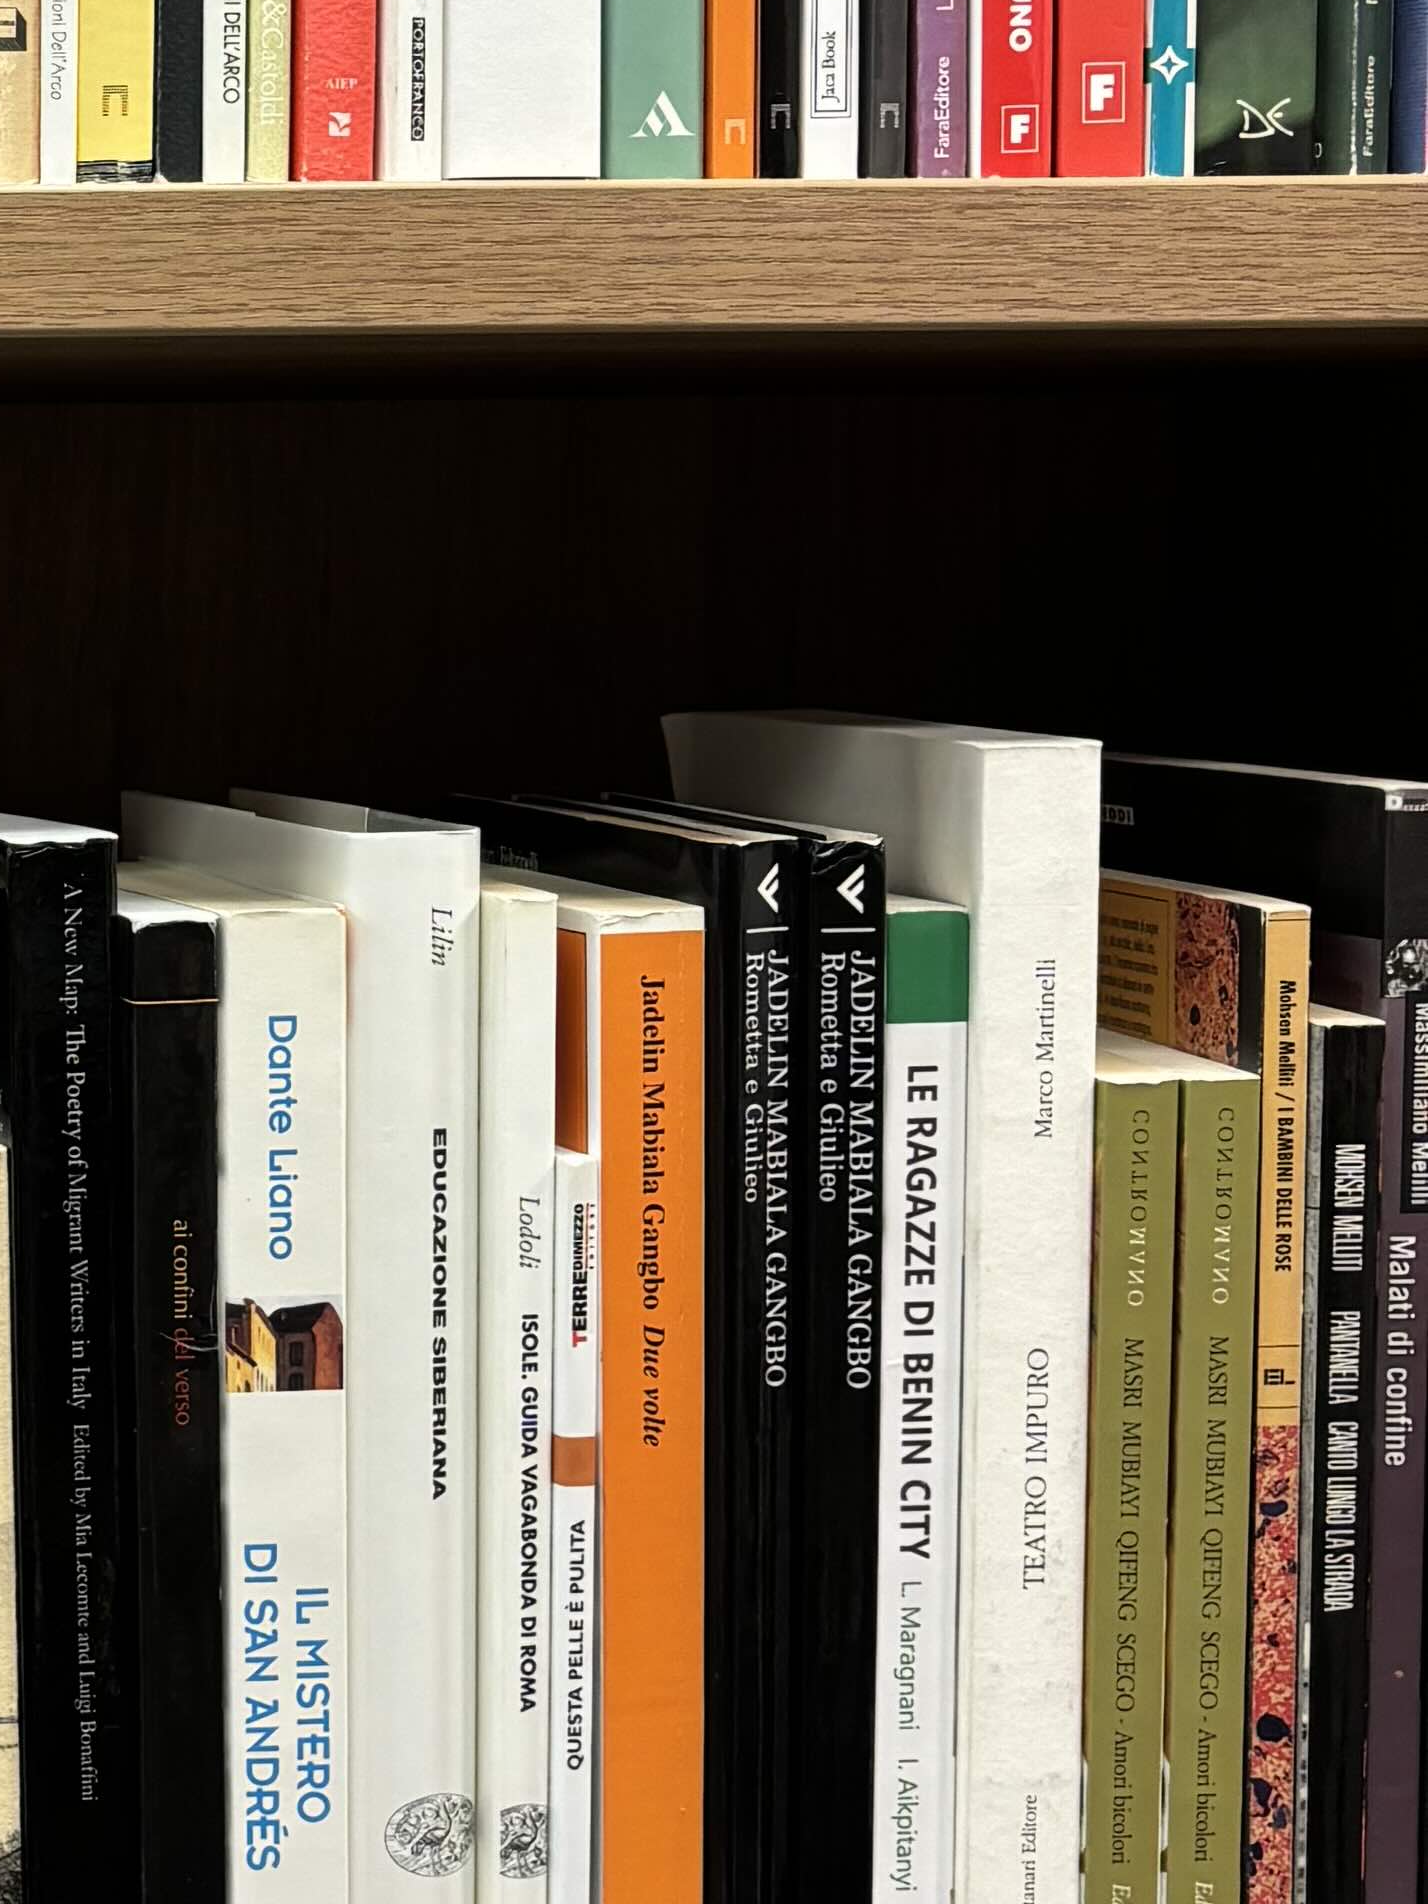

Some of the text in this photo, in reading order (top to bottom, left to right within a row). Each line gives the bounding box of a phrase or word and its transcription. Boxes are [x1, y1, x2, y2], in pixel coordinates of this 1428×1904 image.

[432, 907, 454, 966] Lilin
[268, 1016, 298, 1260] Dante Liano
[432, 1128, 447, 1500] EDUCAZIONE SIBERIANA
[900, 1065, 938, 1559] LE RAGAZZE DI BENIN CITY
[1385, 1236, 1416, 1466] Malati di confine
[244, 1544, 289, 1870] DI SAN ANDRÉS
[296, 1588, 330, 1823] IL MISTERO
